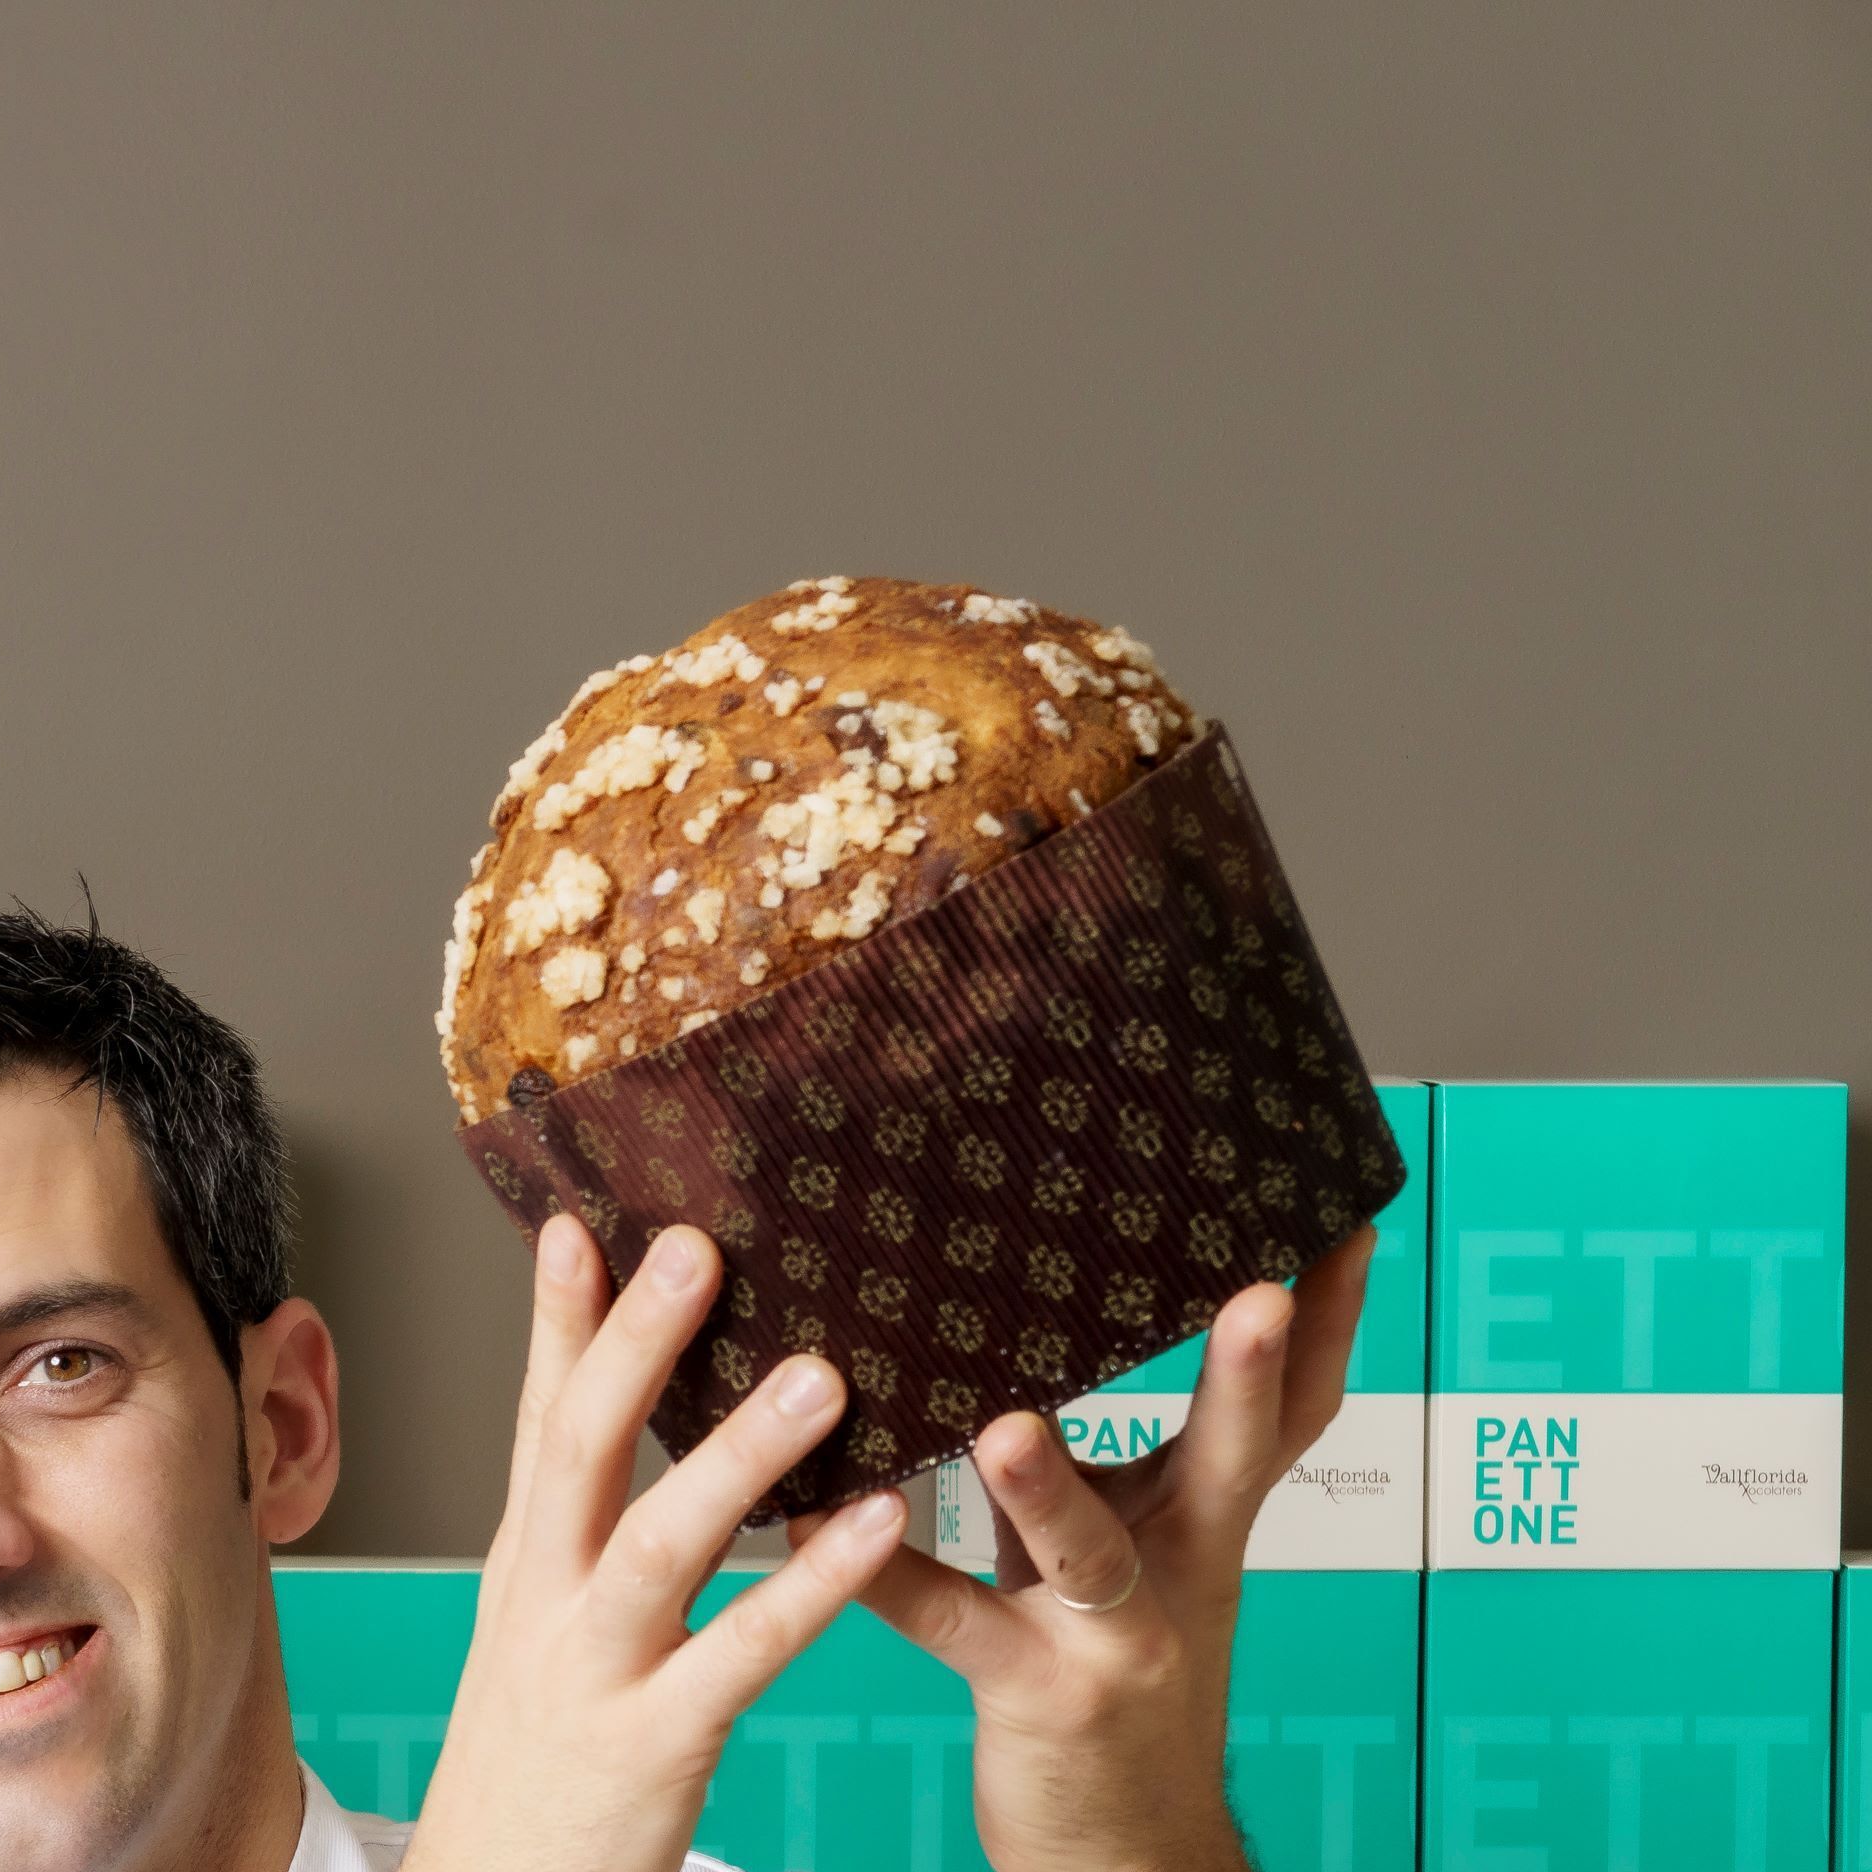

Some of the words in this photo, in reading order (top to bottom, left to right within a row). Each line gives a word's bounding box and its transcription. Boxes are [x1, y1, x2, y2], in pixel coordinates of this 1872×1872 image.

[1458, 1231, 1823, 1389] ETT
[1060, 1417, 1160, 1457] PAN
[1476, 1418, 1578, 1457] PAN
[1322, 1481, 1384, 1503] Xocolaters
[1475, 1461, 1579, 1500] ETT
[1701, 1464, 1808, 1484] Vallflorida
[1739, 1482, 1802, 1504] Xocolaters
[1473, 1505, 1577, 1544] ONE
